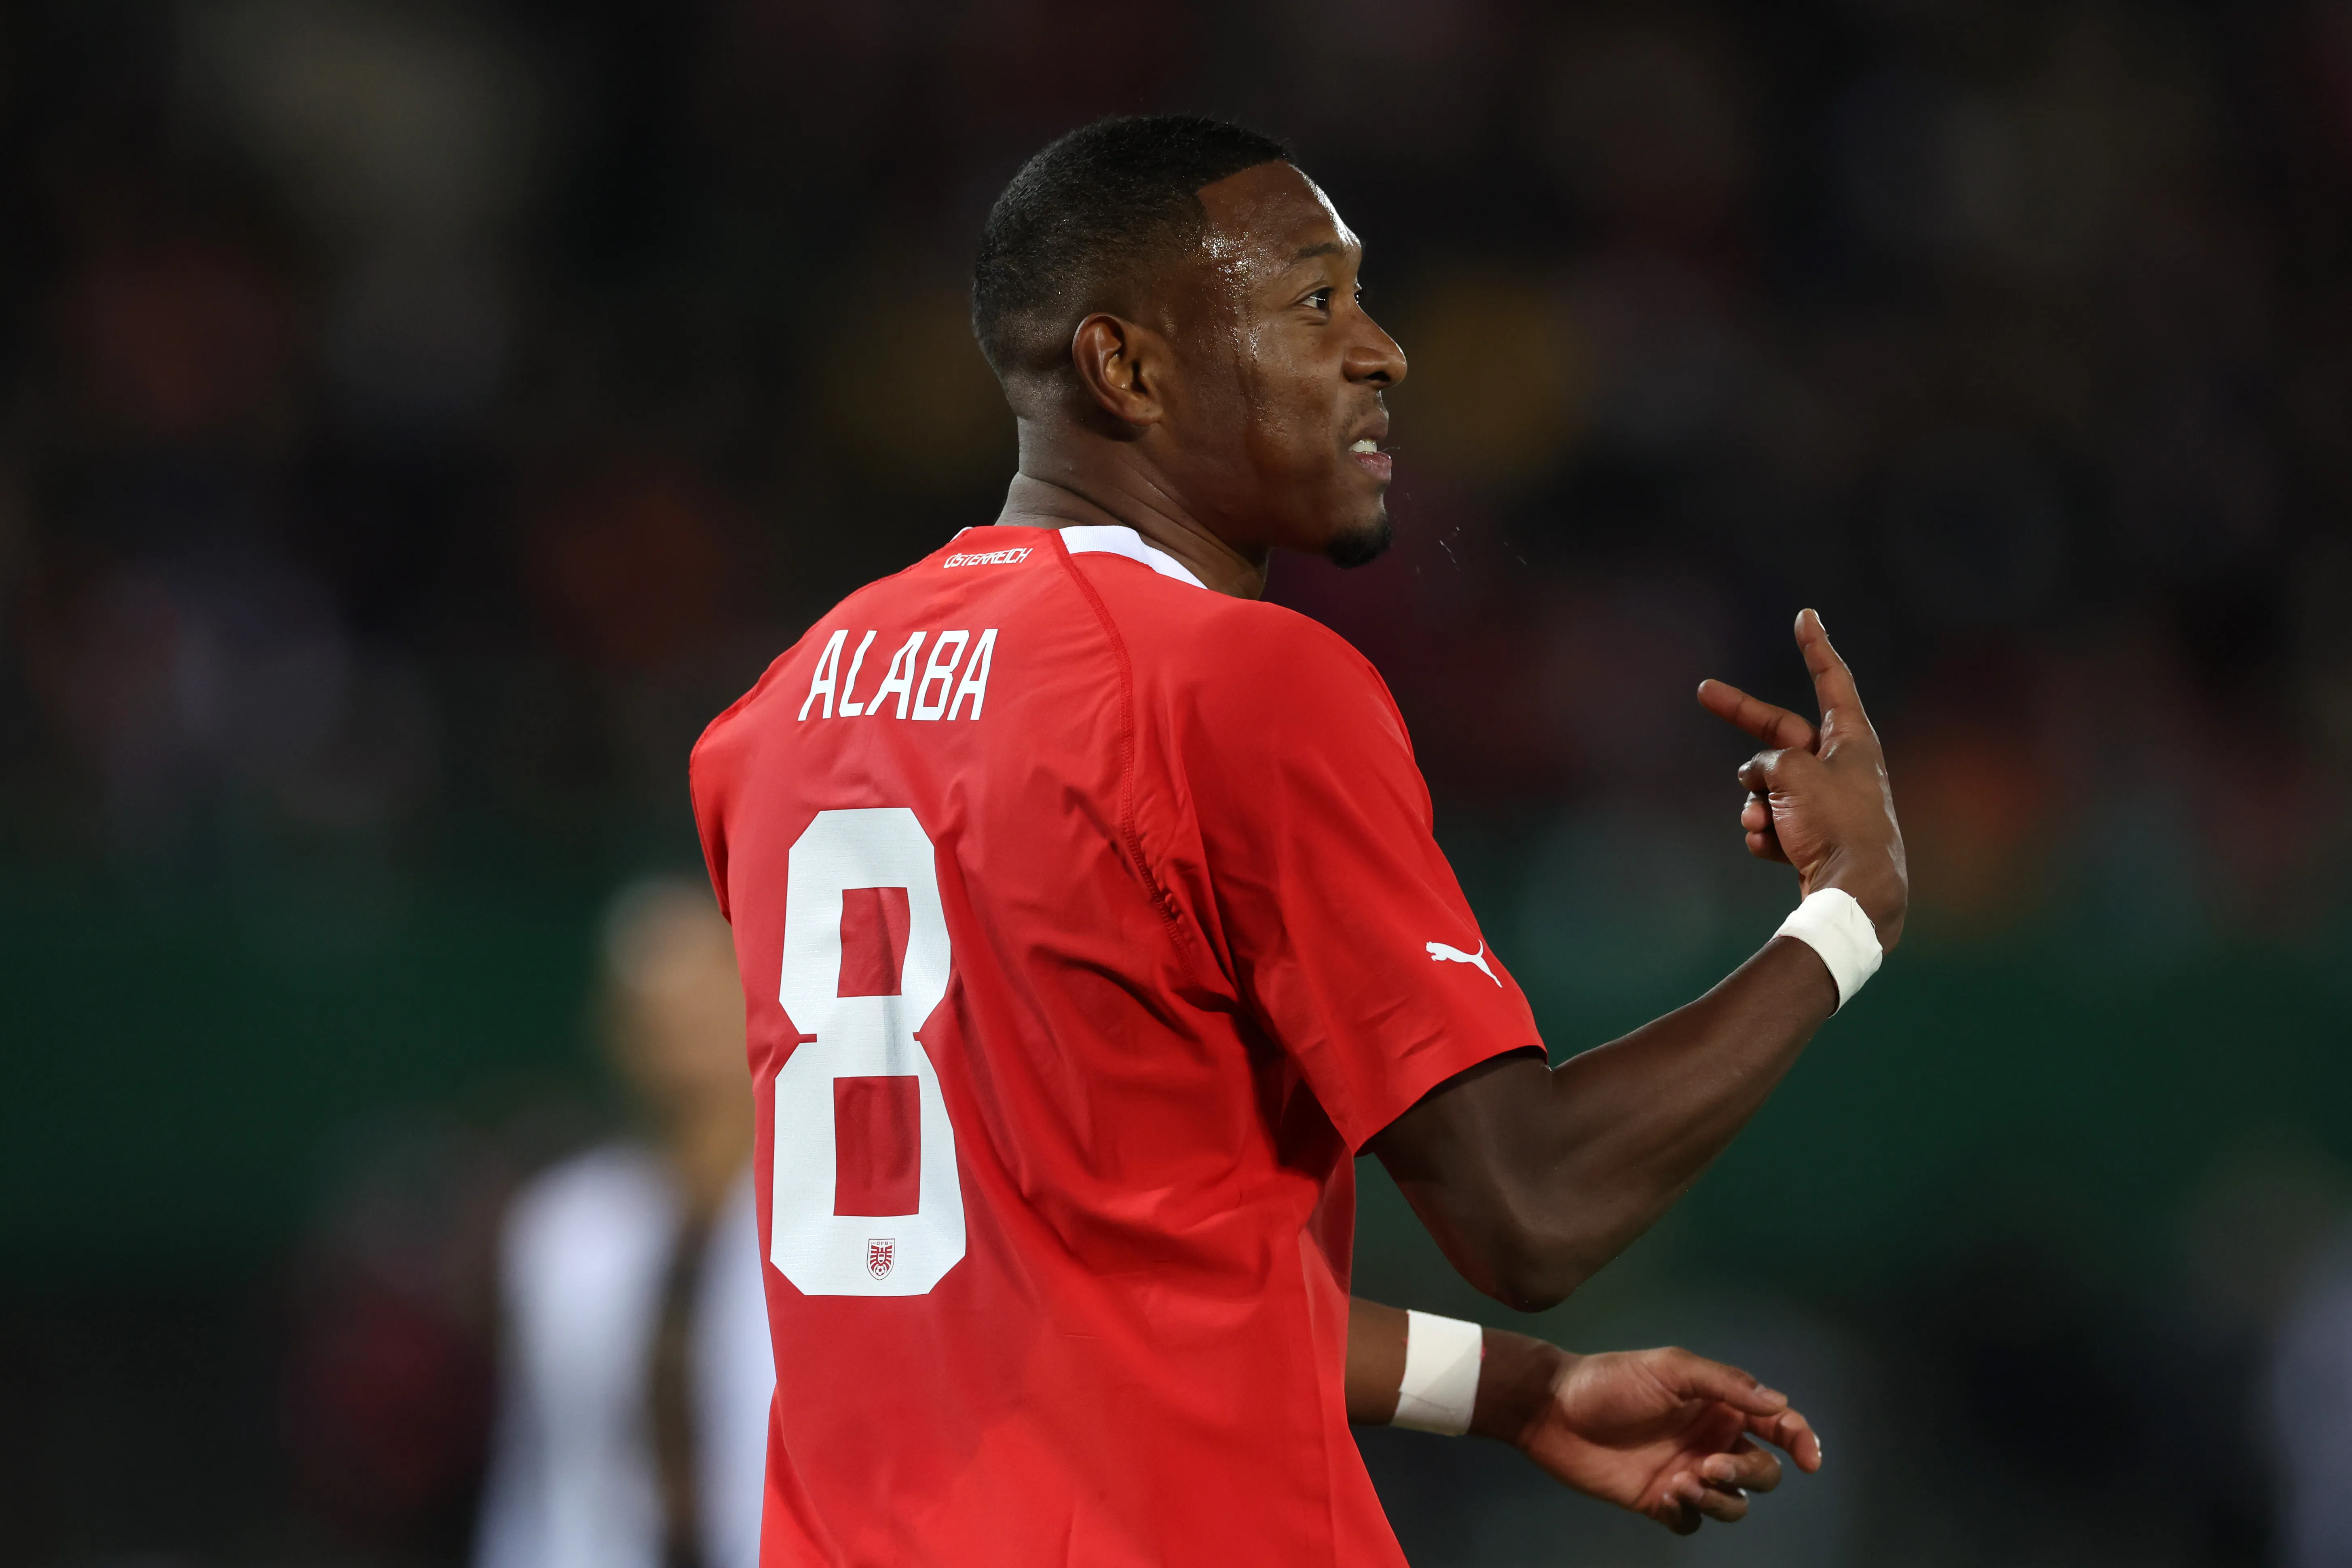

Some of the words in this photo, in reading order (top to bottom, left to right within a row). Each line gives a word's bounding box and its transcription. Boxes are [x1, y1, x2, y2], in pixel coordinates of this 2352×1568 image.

[943, 548, 1033, 568] ÖSTERREICH
[797, 628, 999, 721] ALABA
[770, 807, 966, 1296] 8
